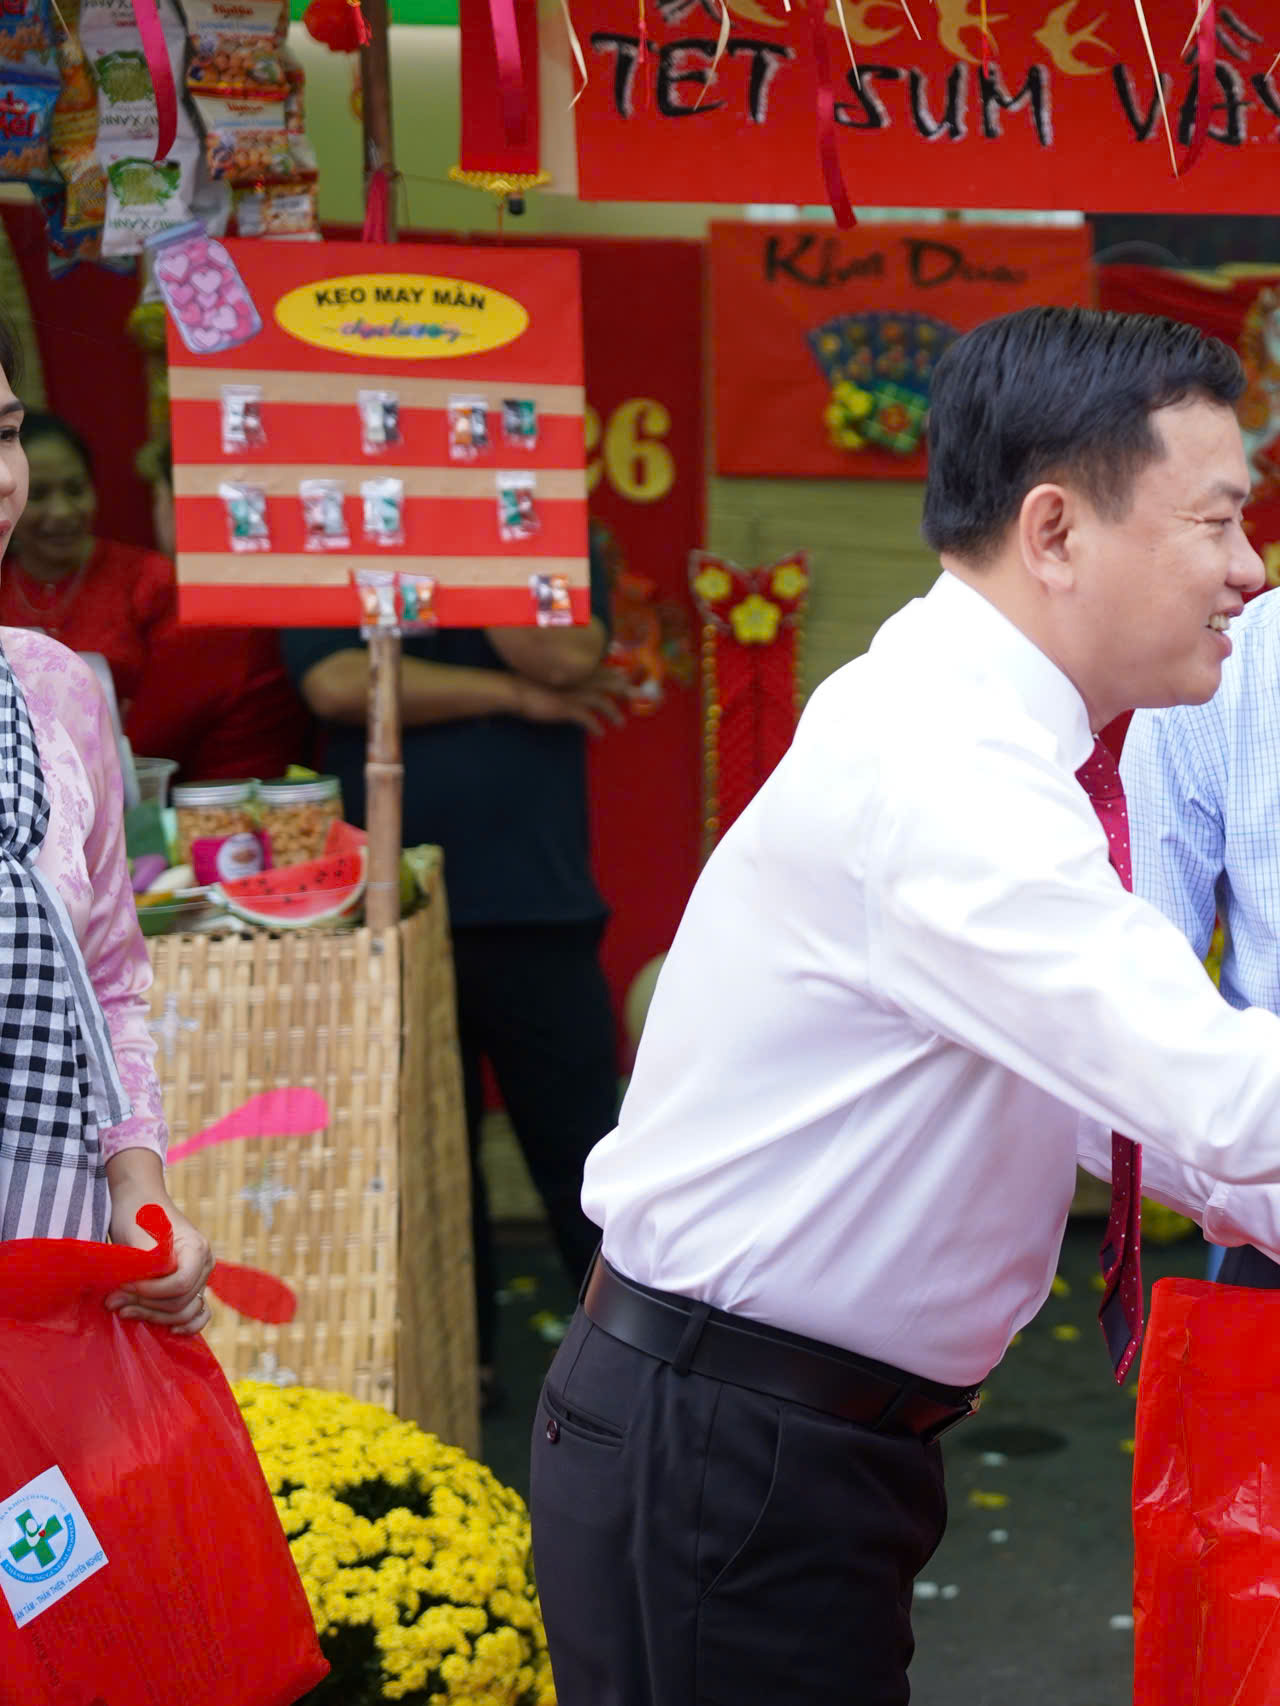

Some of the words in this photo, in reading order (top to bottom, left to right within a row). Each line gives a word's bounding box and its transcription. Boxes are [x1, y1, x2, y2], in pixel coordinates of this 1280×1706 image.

[834, 62, 1053, 147] SUM
[374, 286, 424, 305] MAY
[584, 396, 677, 504] 6
